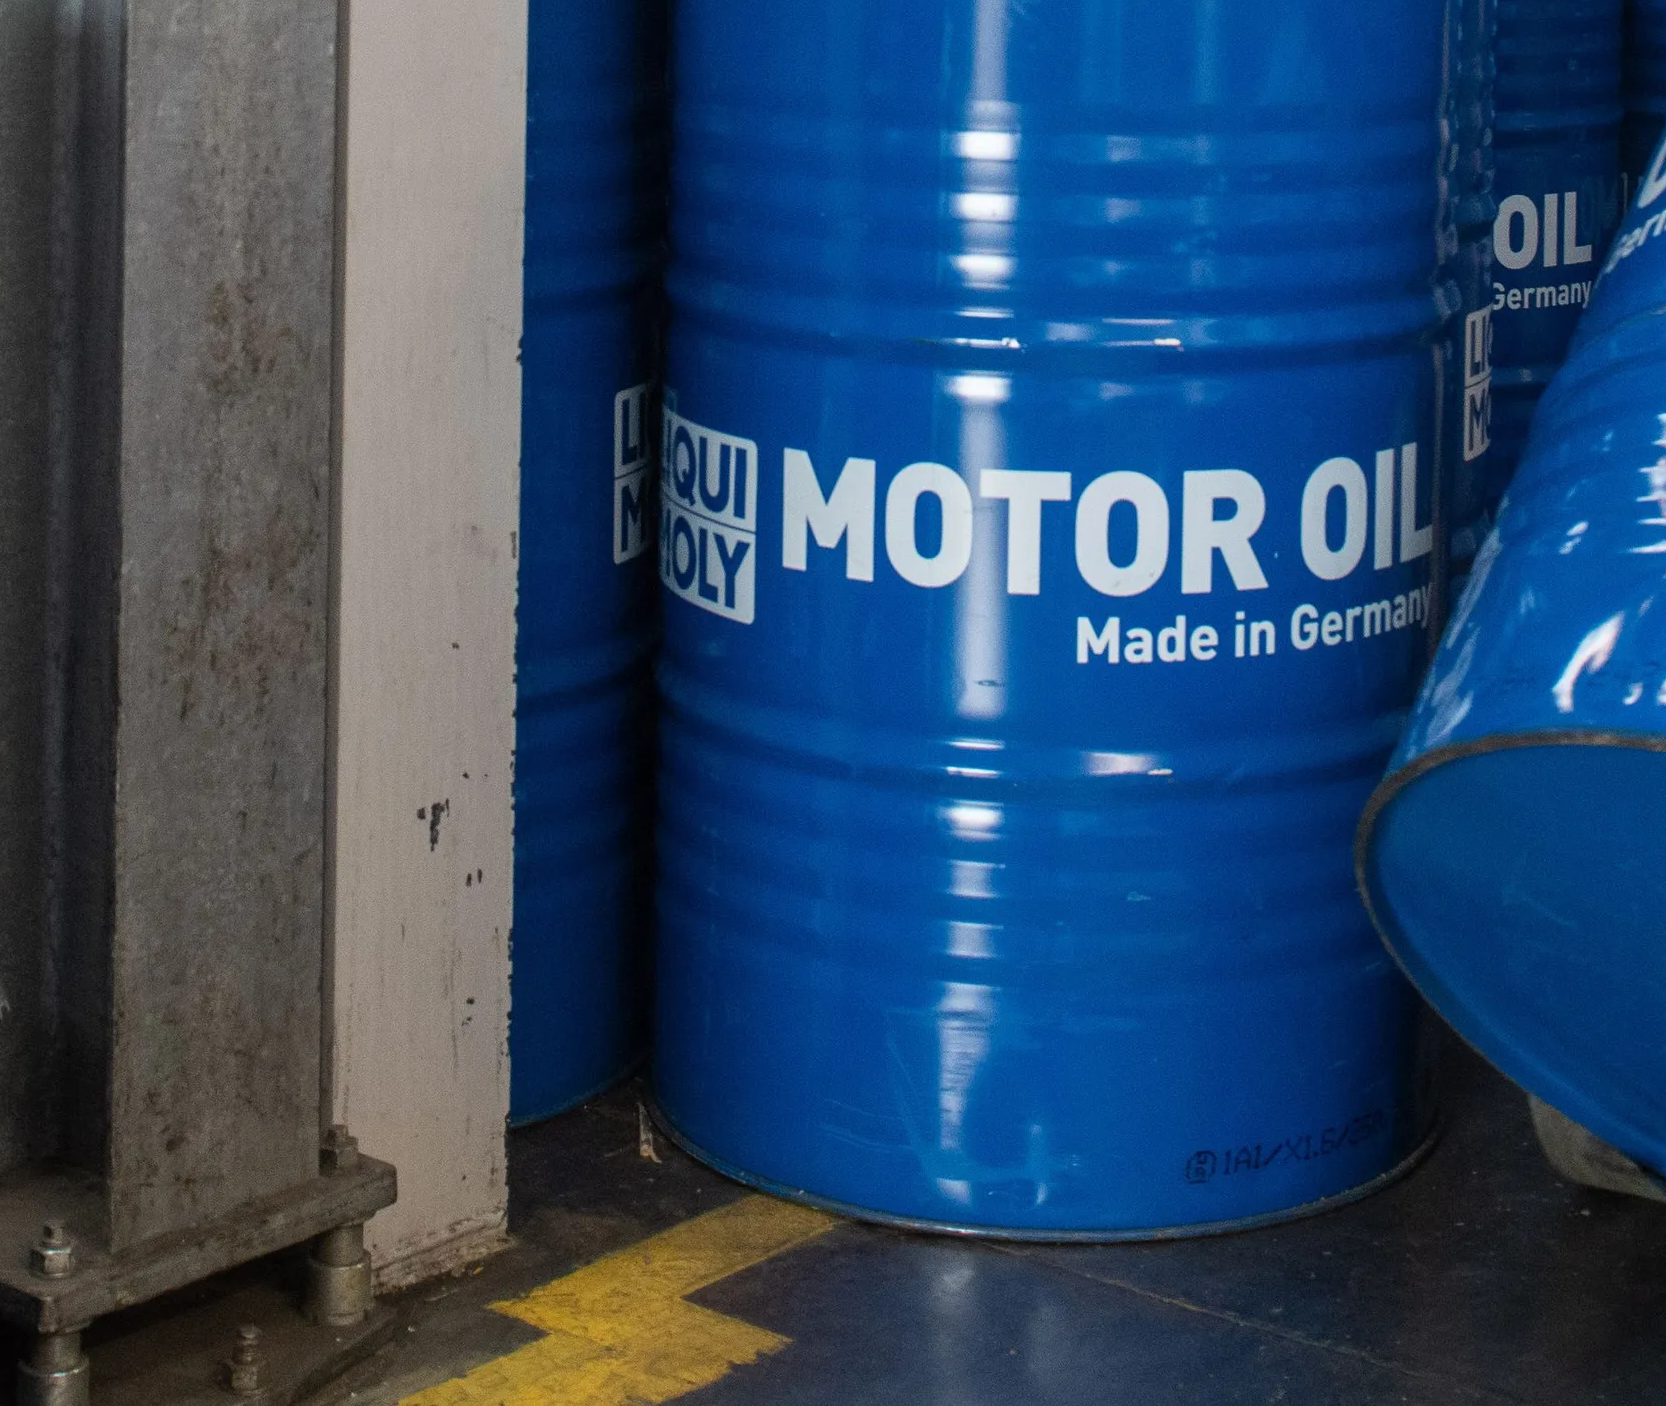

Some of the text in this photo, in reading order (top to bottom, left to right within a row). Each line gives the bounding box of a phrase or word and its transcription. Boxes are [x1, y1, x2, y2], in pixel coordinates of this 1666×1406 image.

[1493, 192, 1593, 270] OIL
[1492, 281, 1591, 310] Germany
[661, 419, 748, 521] IQUI
[783, 448, 1269, 597] MOTOR
[1300, 442, 1433, 581] OIL
[1075, 583, 1434, 665] Made in Germany
